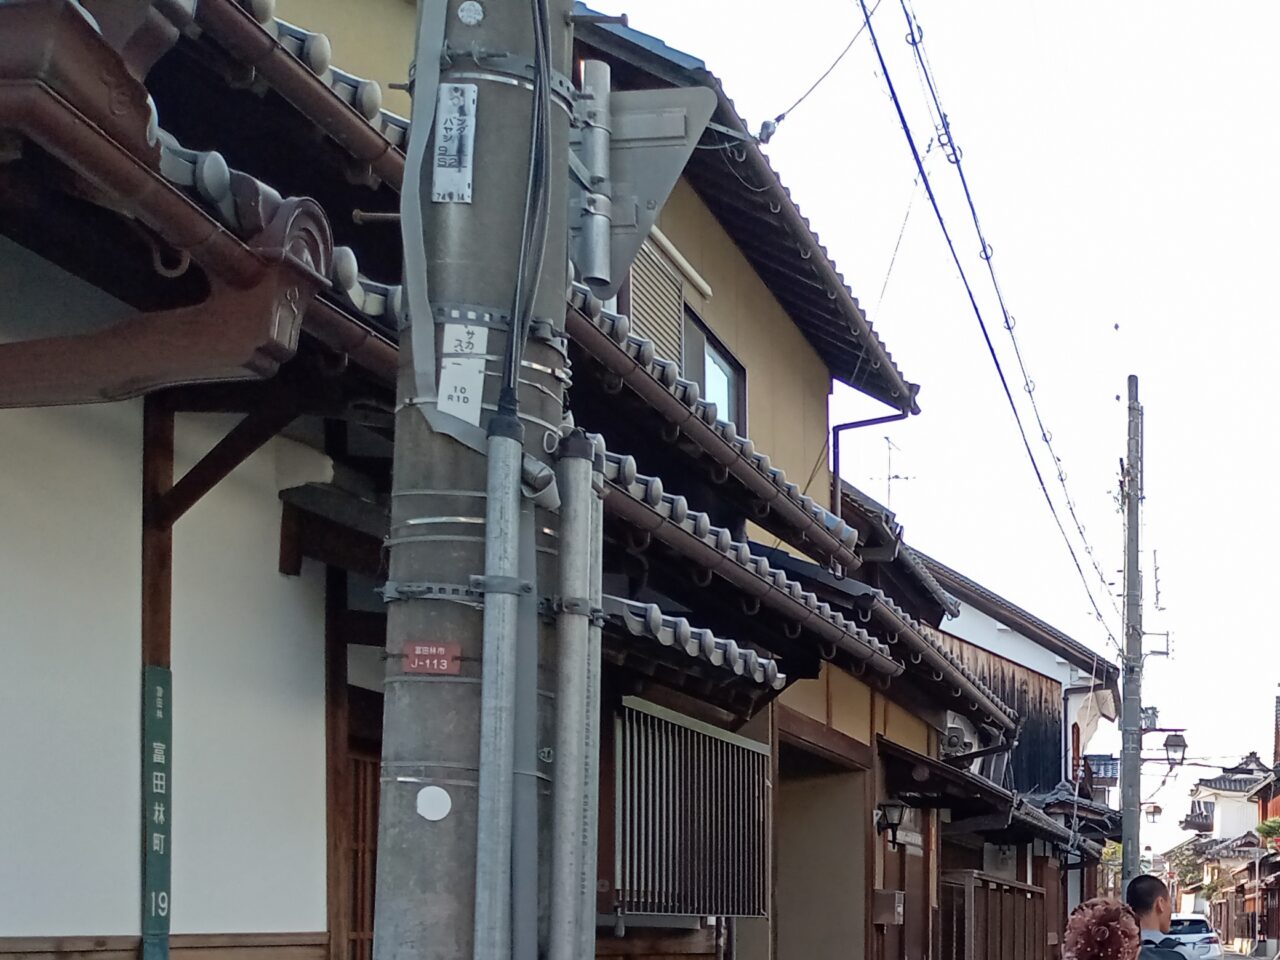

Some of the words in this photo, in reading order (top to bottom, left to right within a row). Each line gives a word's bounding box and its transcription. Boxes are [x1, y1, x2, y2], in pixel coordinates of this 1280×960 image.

[454, 385, 467, 395] 10
[411, 658, 448, 670] J-113
[152, 742, 166, 855] 富田林町
[151, 891, 168, 917] 19
